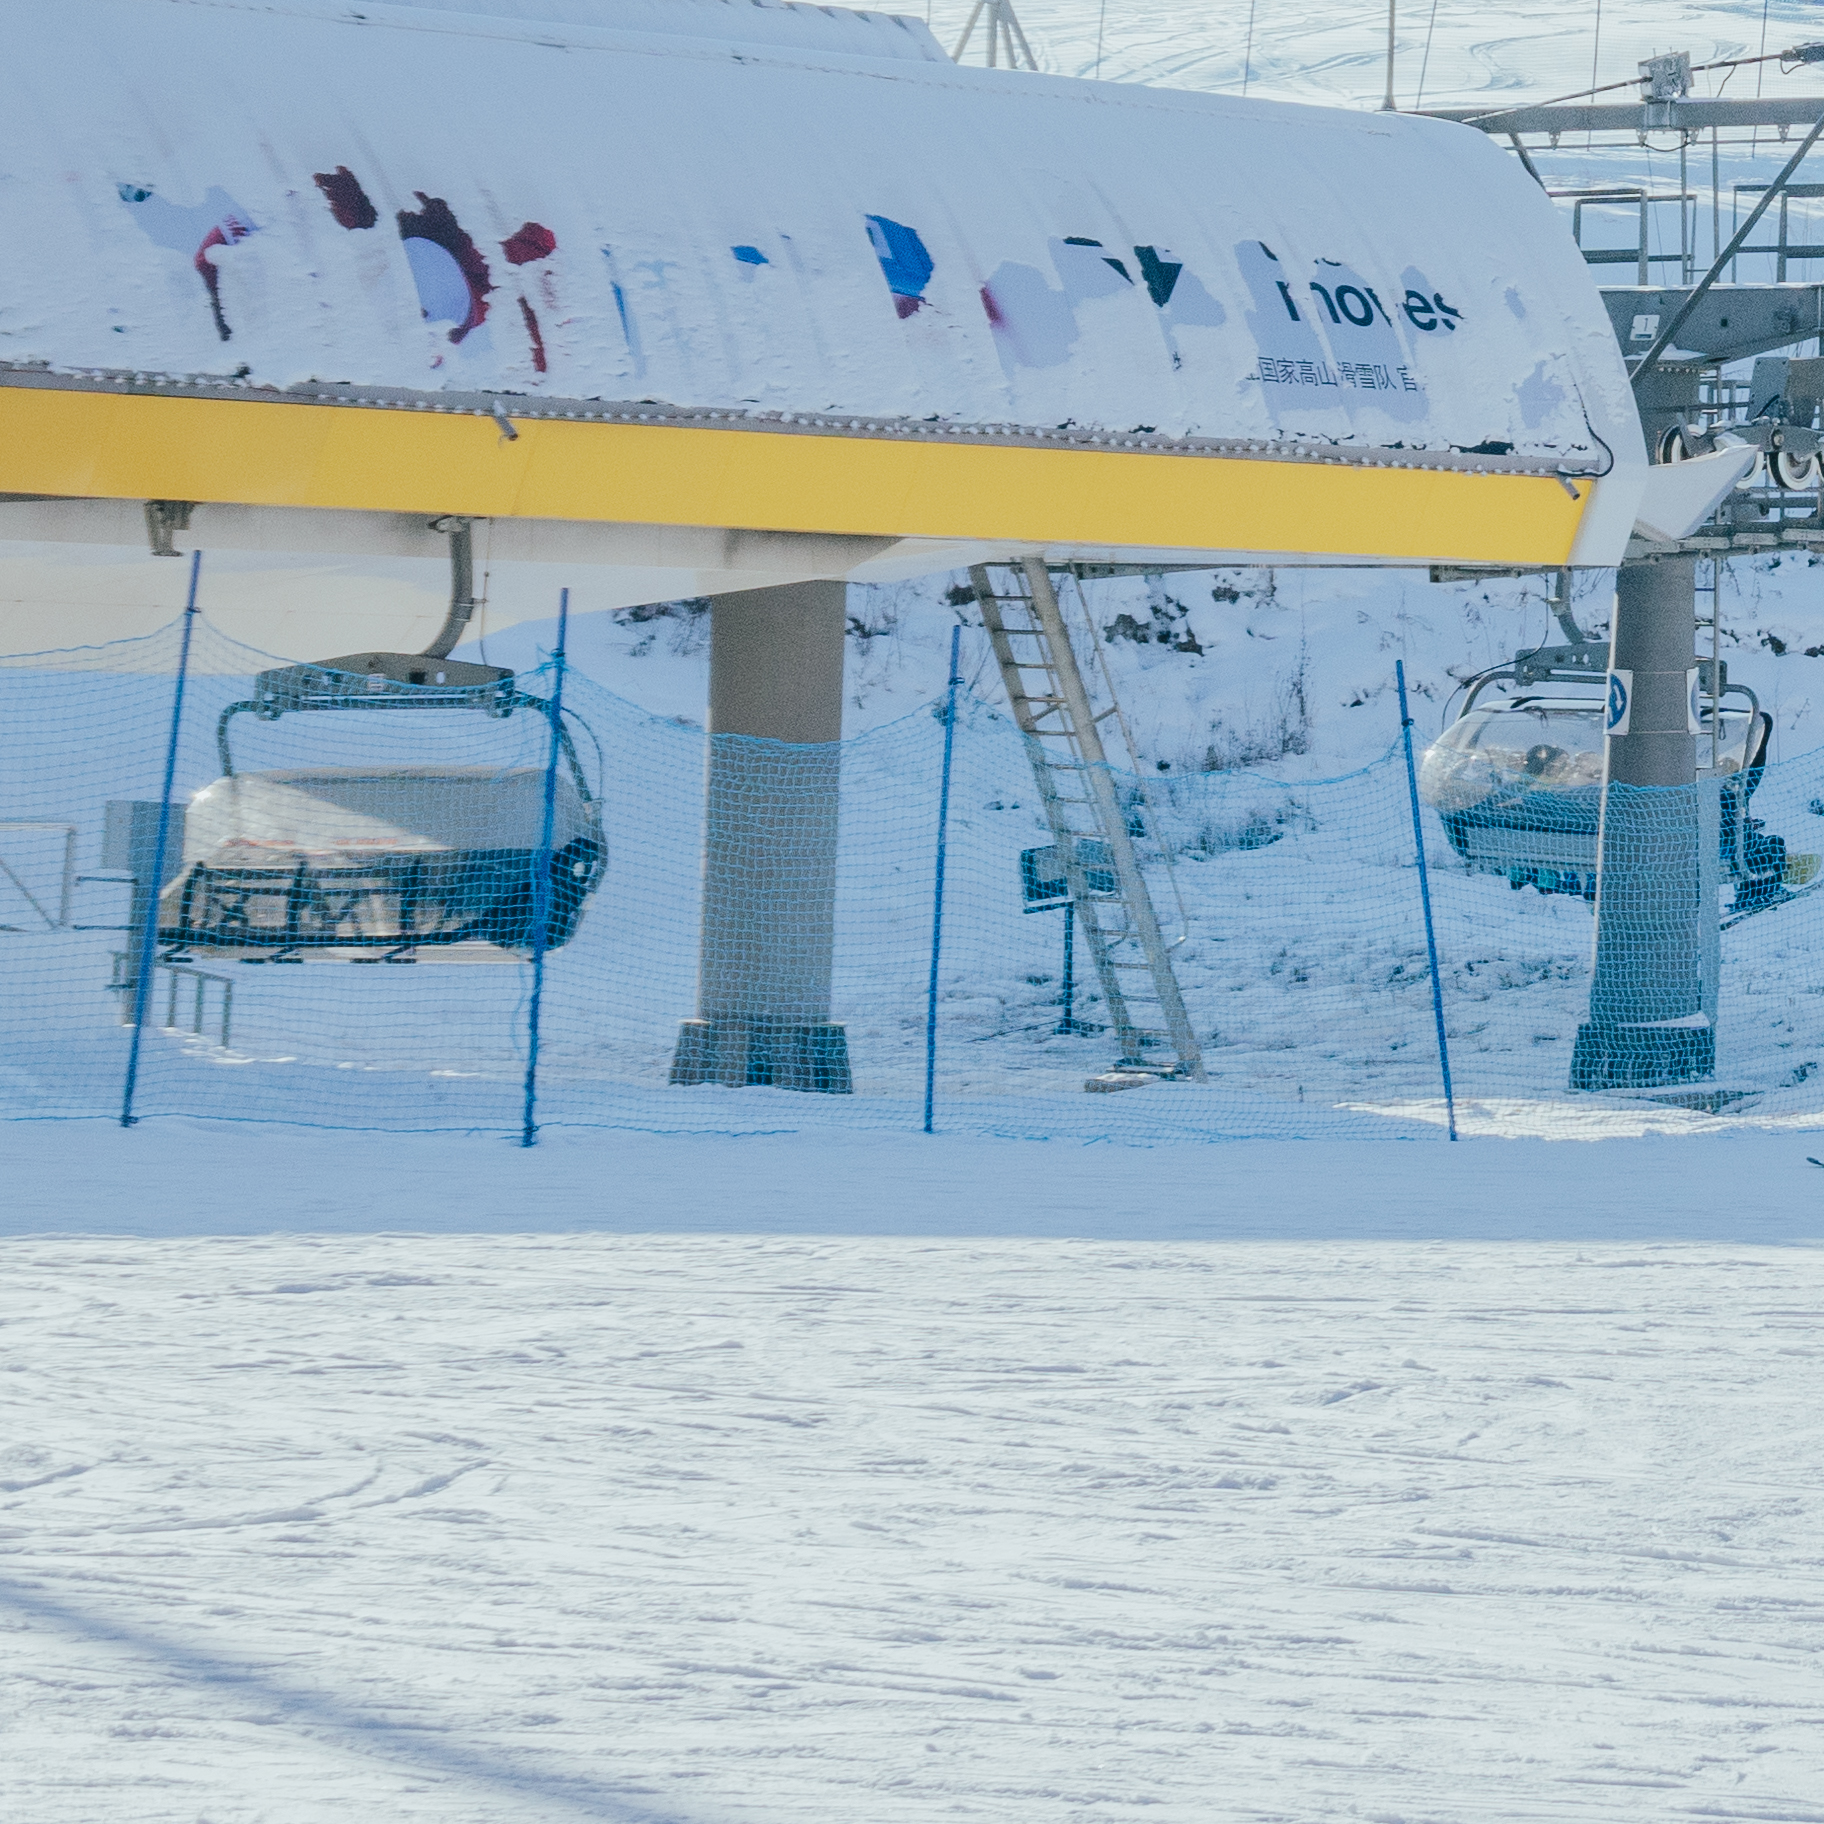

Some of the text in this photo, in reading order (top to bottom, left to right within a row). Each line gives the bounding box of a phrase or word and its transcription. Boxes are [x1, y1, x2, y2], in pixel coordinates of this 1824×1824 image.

[1247, 356, 1397, 390] 国家高山滑雪队
